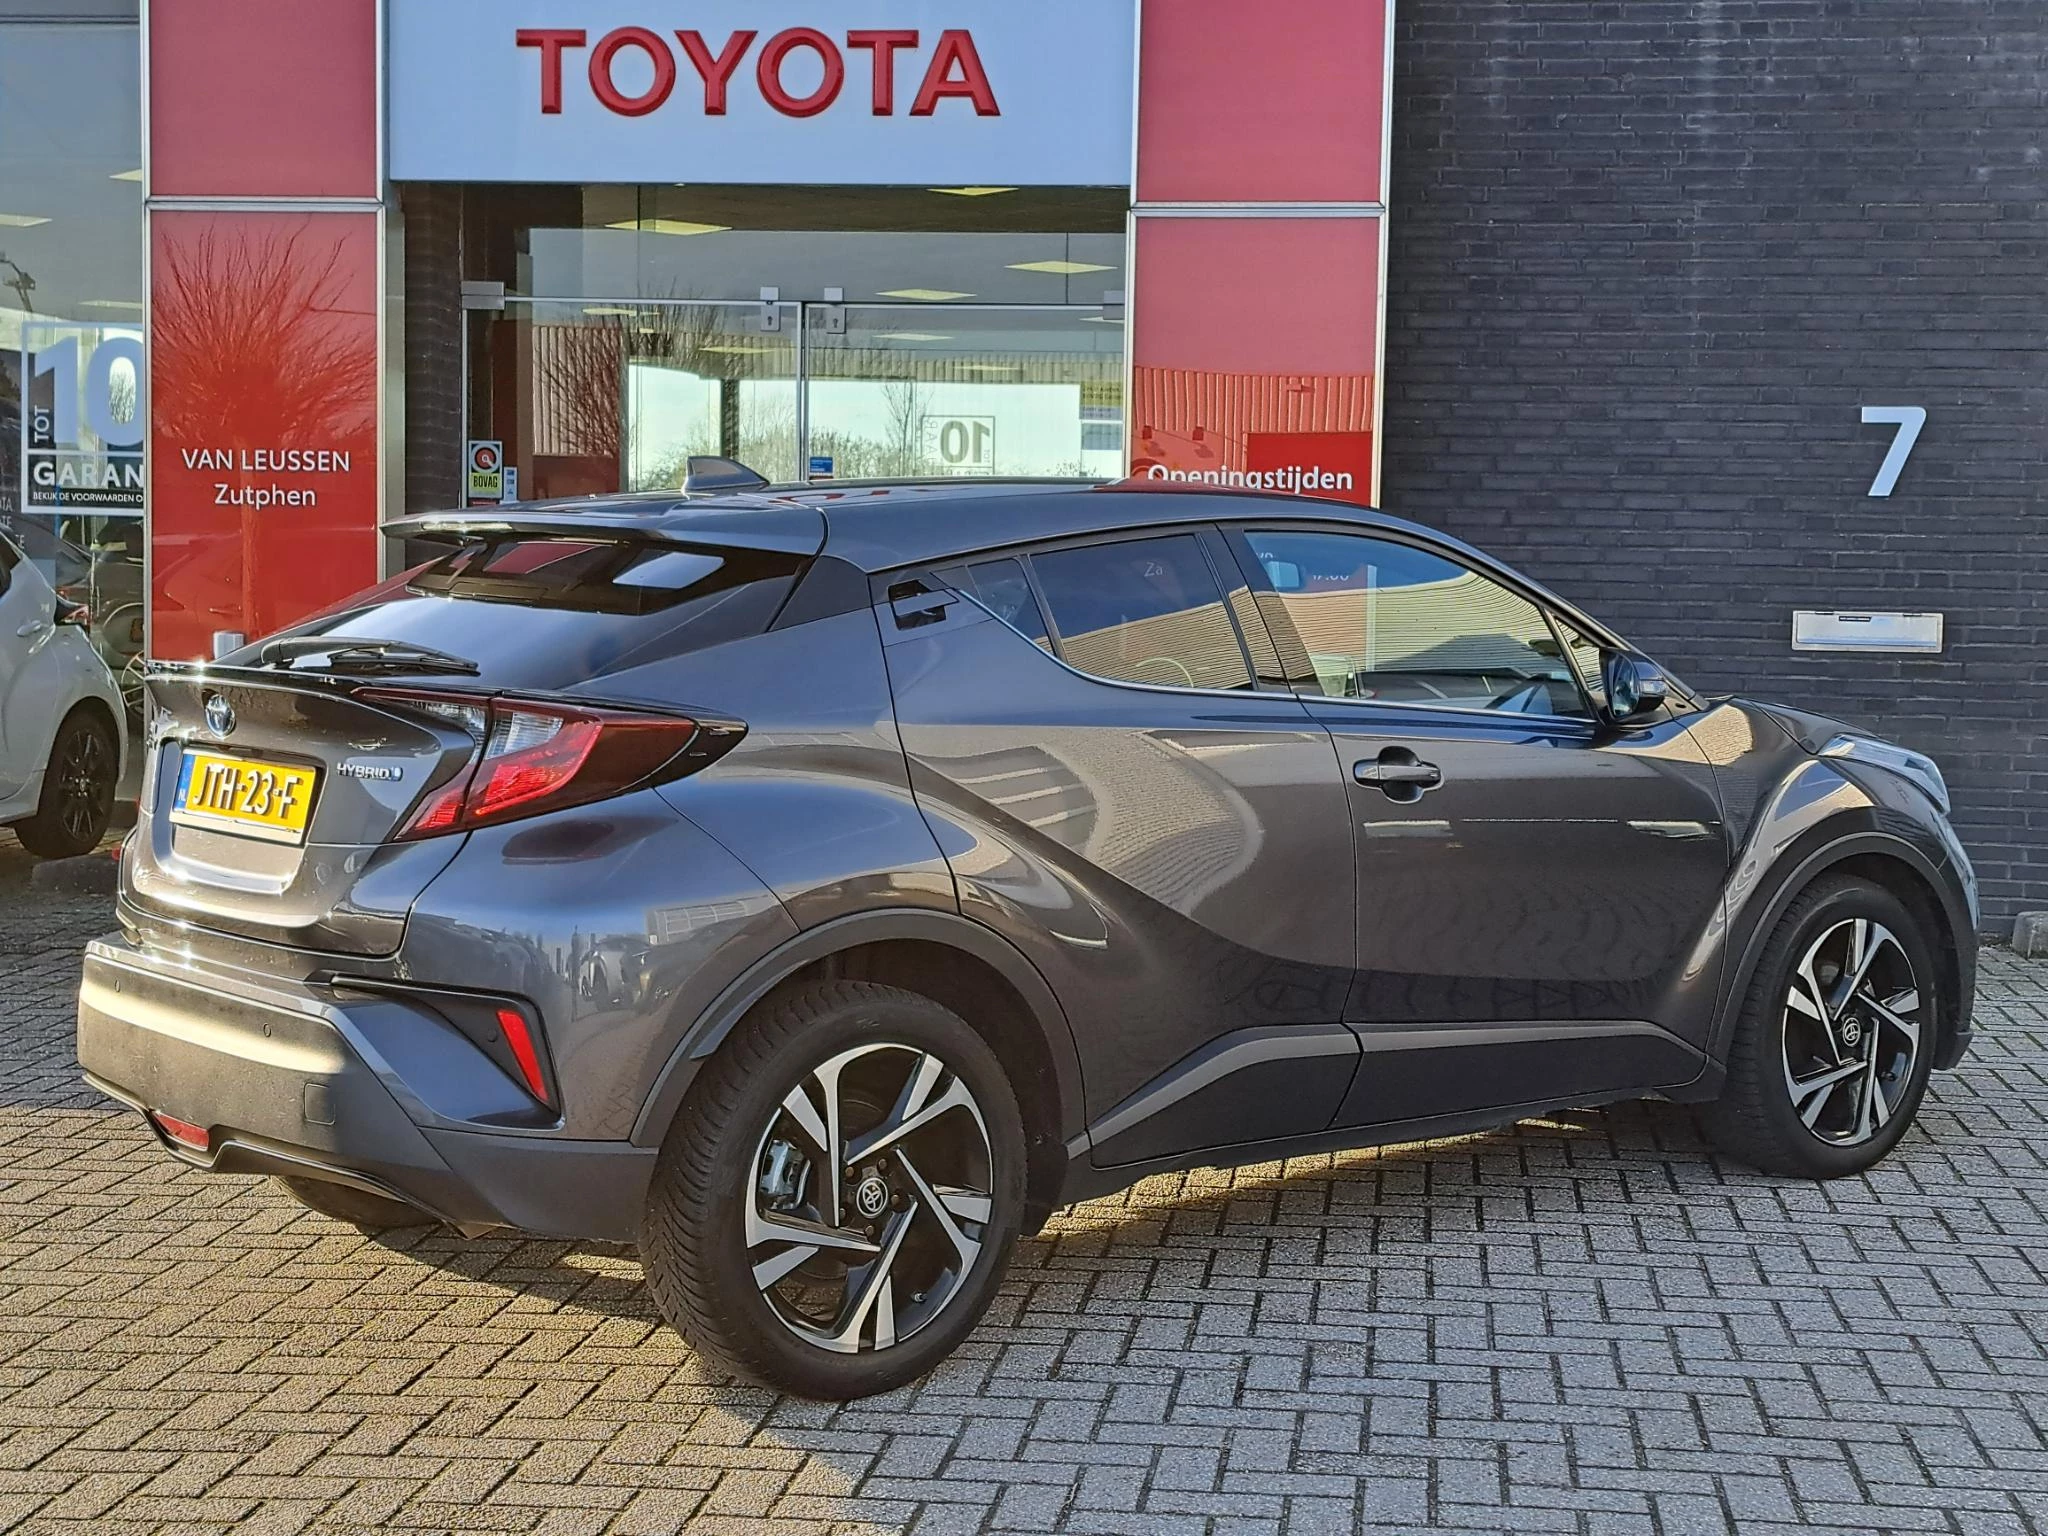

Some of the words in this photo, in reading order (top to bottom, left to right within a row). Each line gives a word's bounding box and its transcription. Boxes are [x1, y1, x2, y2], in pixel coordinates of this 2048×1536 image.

[516, 26, 1001, 118] TOYOTA
[35, 336, 143, 446] 10
[34, 404, 49, 443] TOT
[182, 448, 233, 470] VAN
[241, 449, 350, 472] LEUSSEN
[1861, 406, 1927, 497] 7
[33, 461, 143, 488] GARAN
[473, 475, 498, 488] BOVAG
[33, 491, 58, 500] BEKIJK
[60, 492, 69, 500] DE
[71, 493, 134, 503] VOORWAARDEN
[214, 483, 316, 511] Zutphen
[1144, 561, 1163, 577] Za
[336, 762, 390, 780] HYBRID
[192, 762, 301, 819] JTH-23-F
